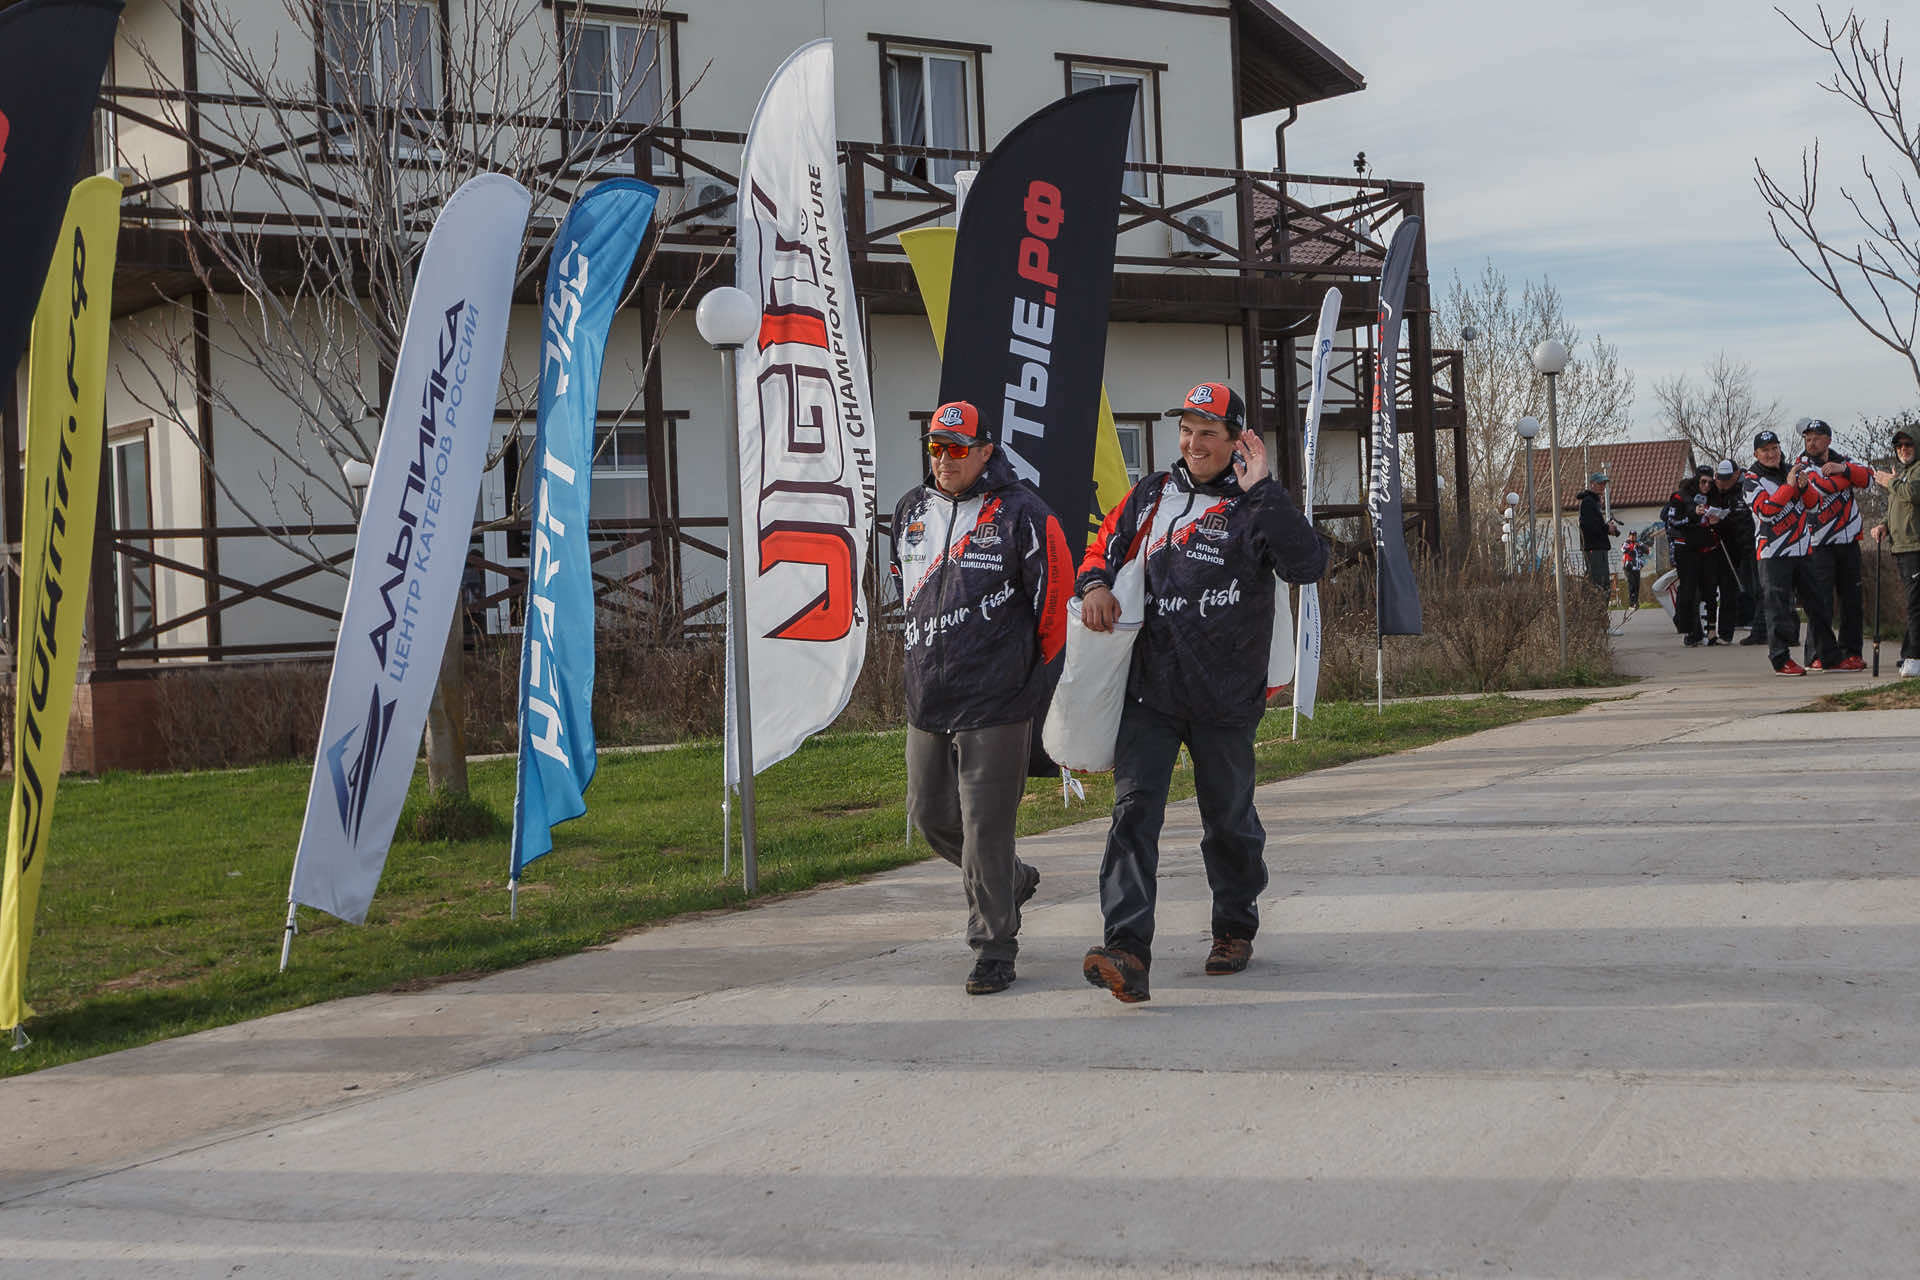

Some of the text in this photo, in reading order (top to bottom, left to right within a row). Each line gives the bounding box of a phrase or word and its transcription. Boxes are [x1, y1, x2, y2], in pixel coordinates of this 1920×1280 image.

[808, 163, 834, 279] NATURE
[824, 288, 866, 438] CHAMPION
[1001, 180, 1064, 488] УТЫЕ.РФ
[368, 298, 466, 671] АЛЬПИЙКА
[390, 304, 480, 683] ЦЕНТР КАТЕРОВ РОССИИ
[960, 561, 1004, 571] ШИШАРИН
[963, 552, 1003, 562] НИКОЛАЙ
[1186, 550, 1225, 565] САЗАНОВ
[1195, 542, 1219, 554] ИЛЬЯ
[924, 607, 971, 647] your
[978, 578, 1015, 621] fish
[1199, 578, 1241, 618] fish
